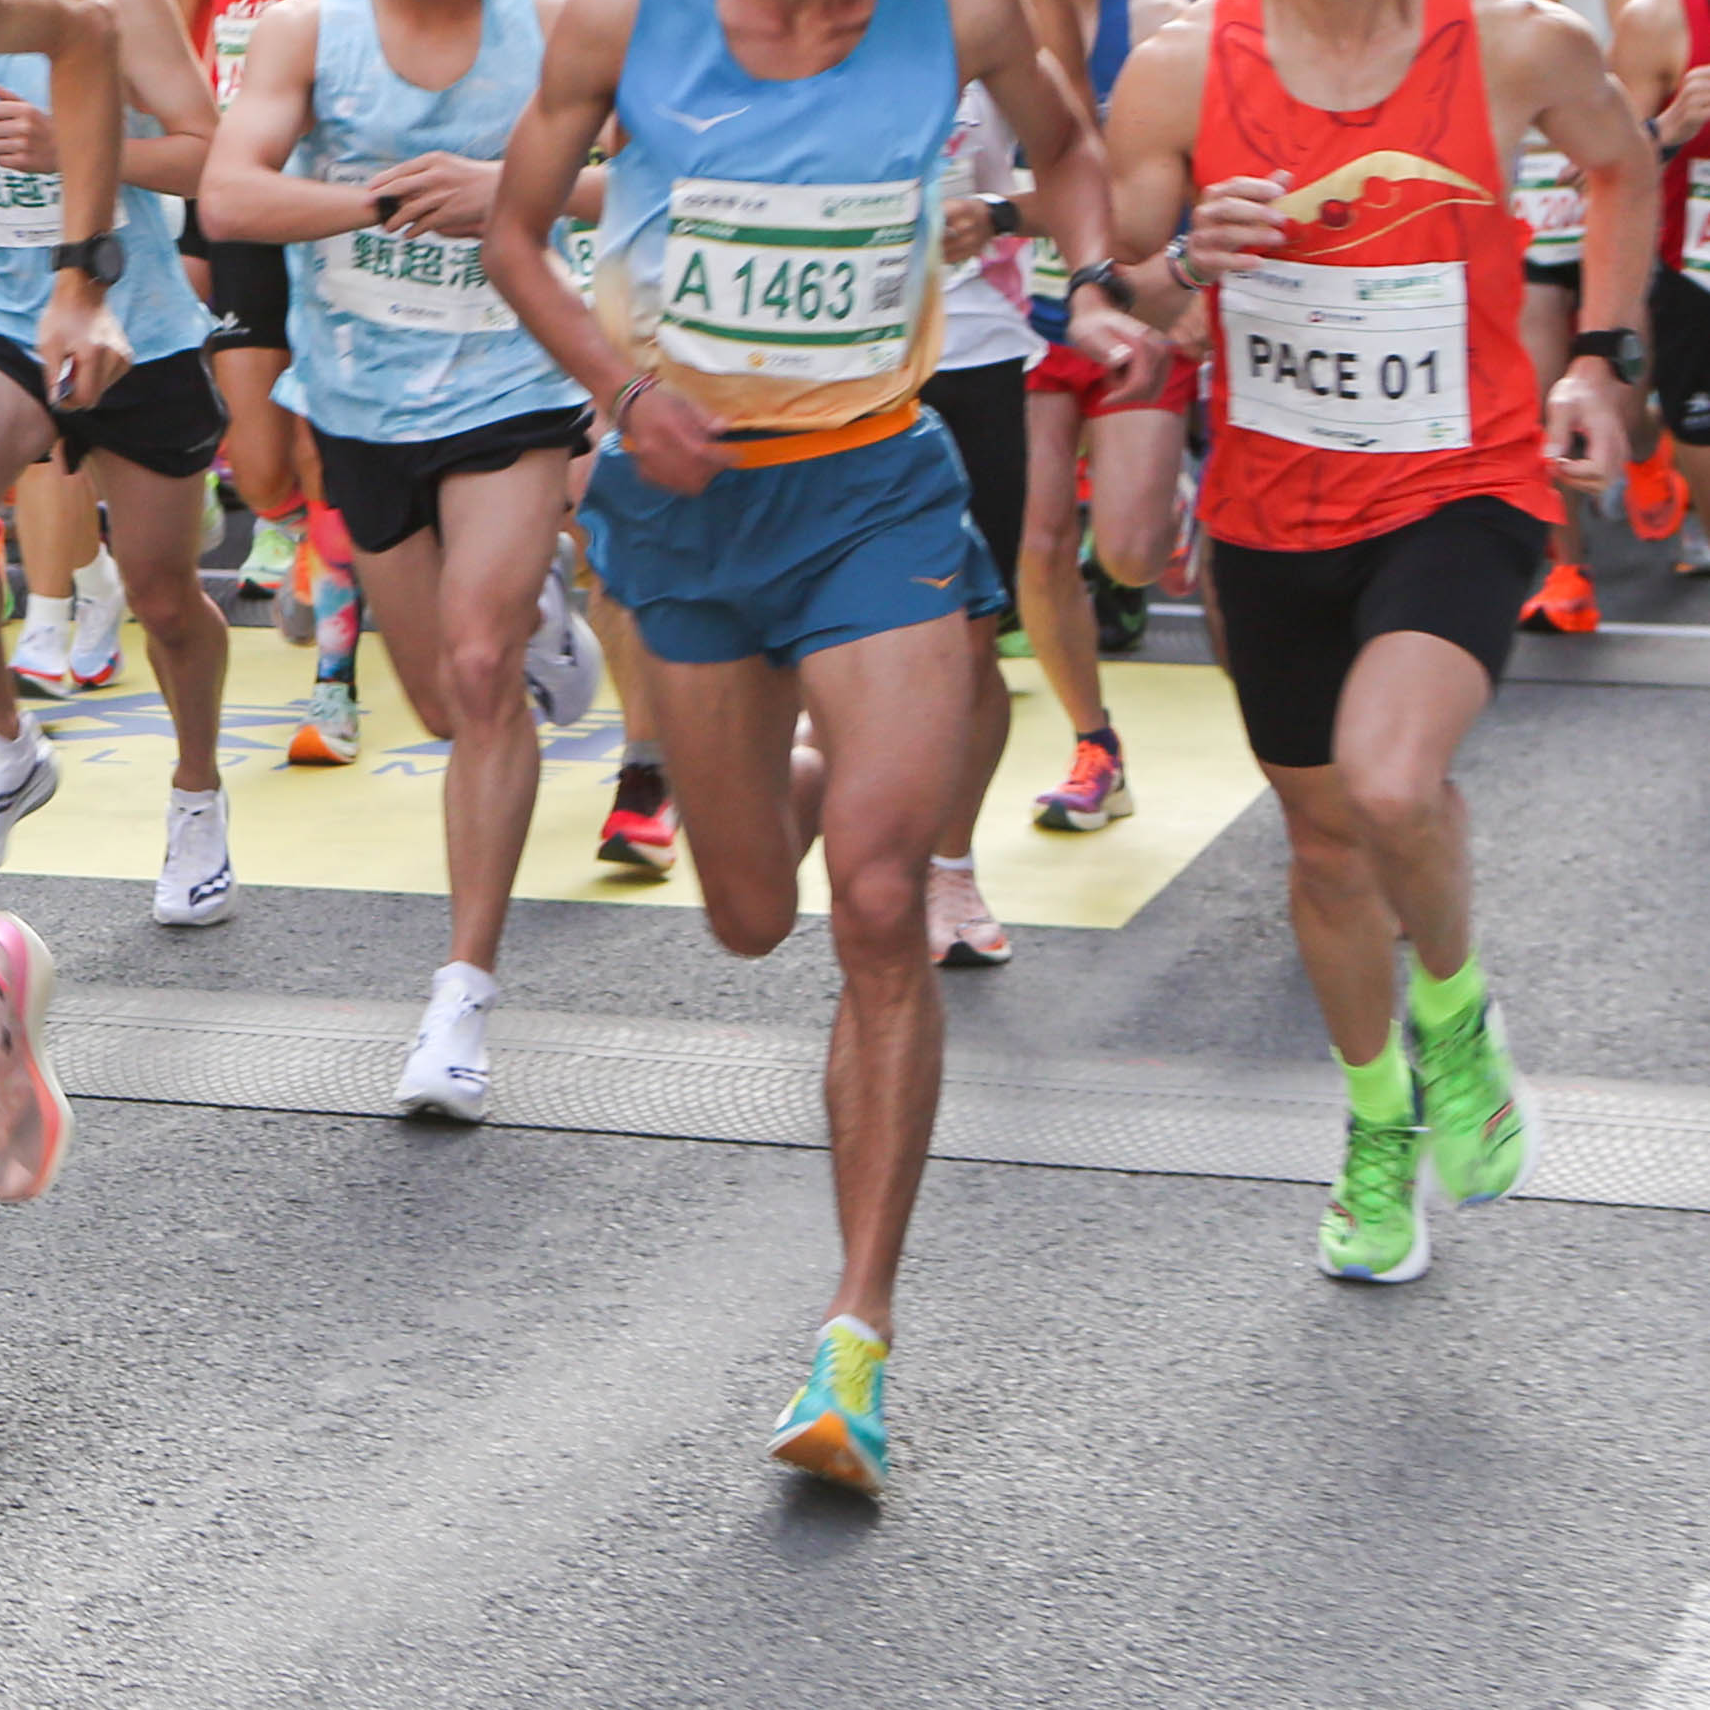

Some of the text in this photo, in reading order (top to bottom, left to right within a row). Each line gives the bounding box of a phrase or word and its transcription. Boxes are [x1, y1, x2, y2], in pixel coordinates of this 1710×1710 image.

[672, 250, 857, 321] A 1463
[1247, 333, 1440, 401] PACE 01
